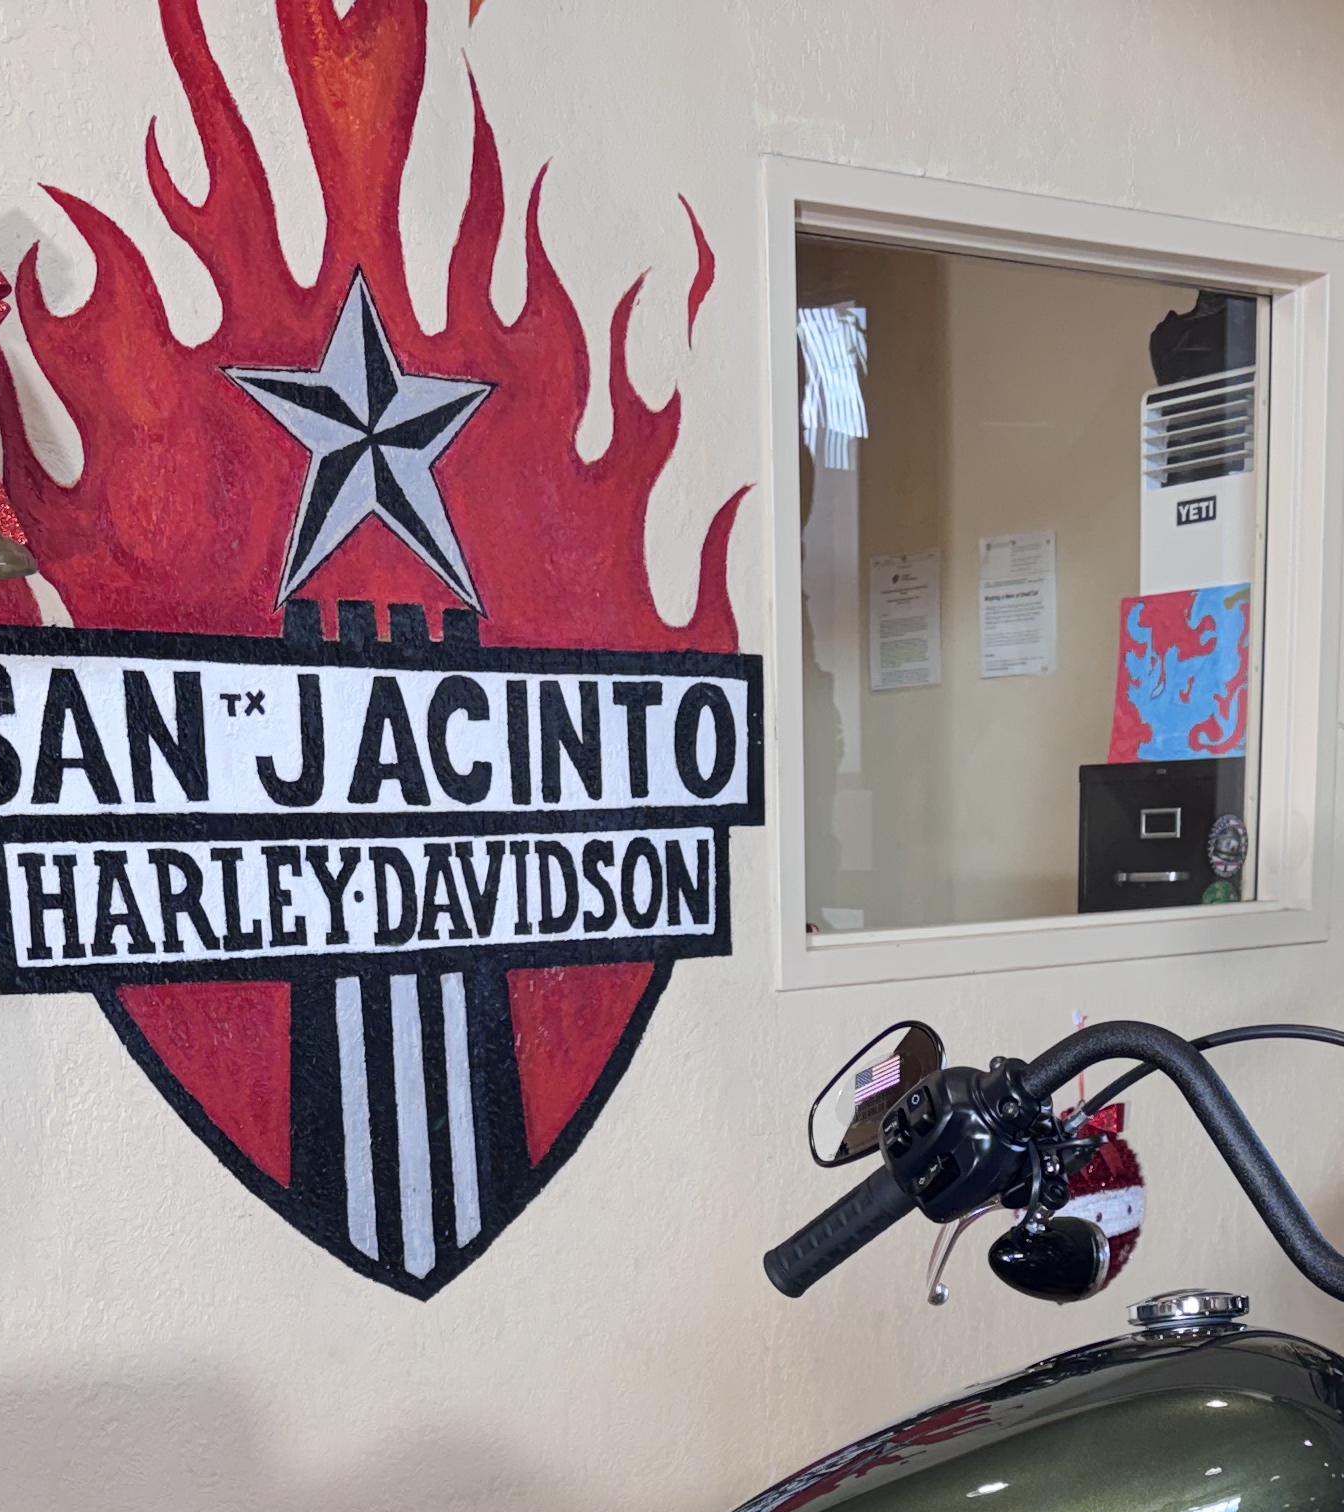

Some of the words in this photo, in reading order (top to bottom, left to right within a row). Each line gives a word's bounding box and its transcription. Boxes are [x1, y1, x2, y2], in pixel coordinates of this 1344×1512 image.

[1178, 500, 1215, 522] YETI
[220, 691, 266, 717] TX
[256, 672, 737, 807] JACINTO
